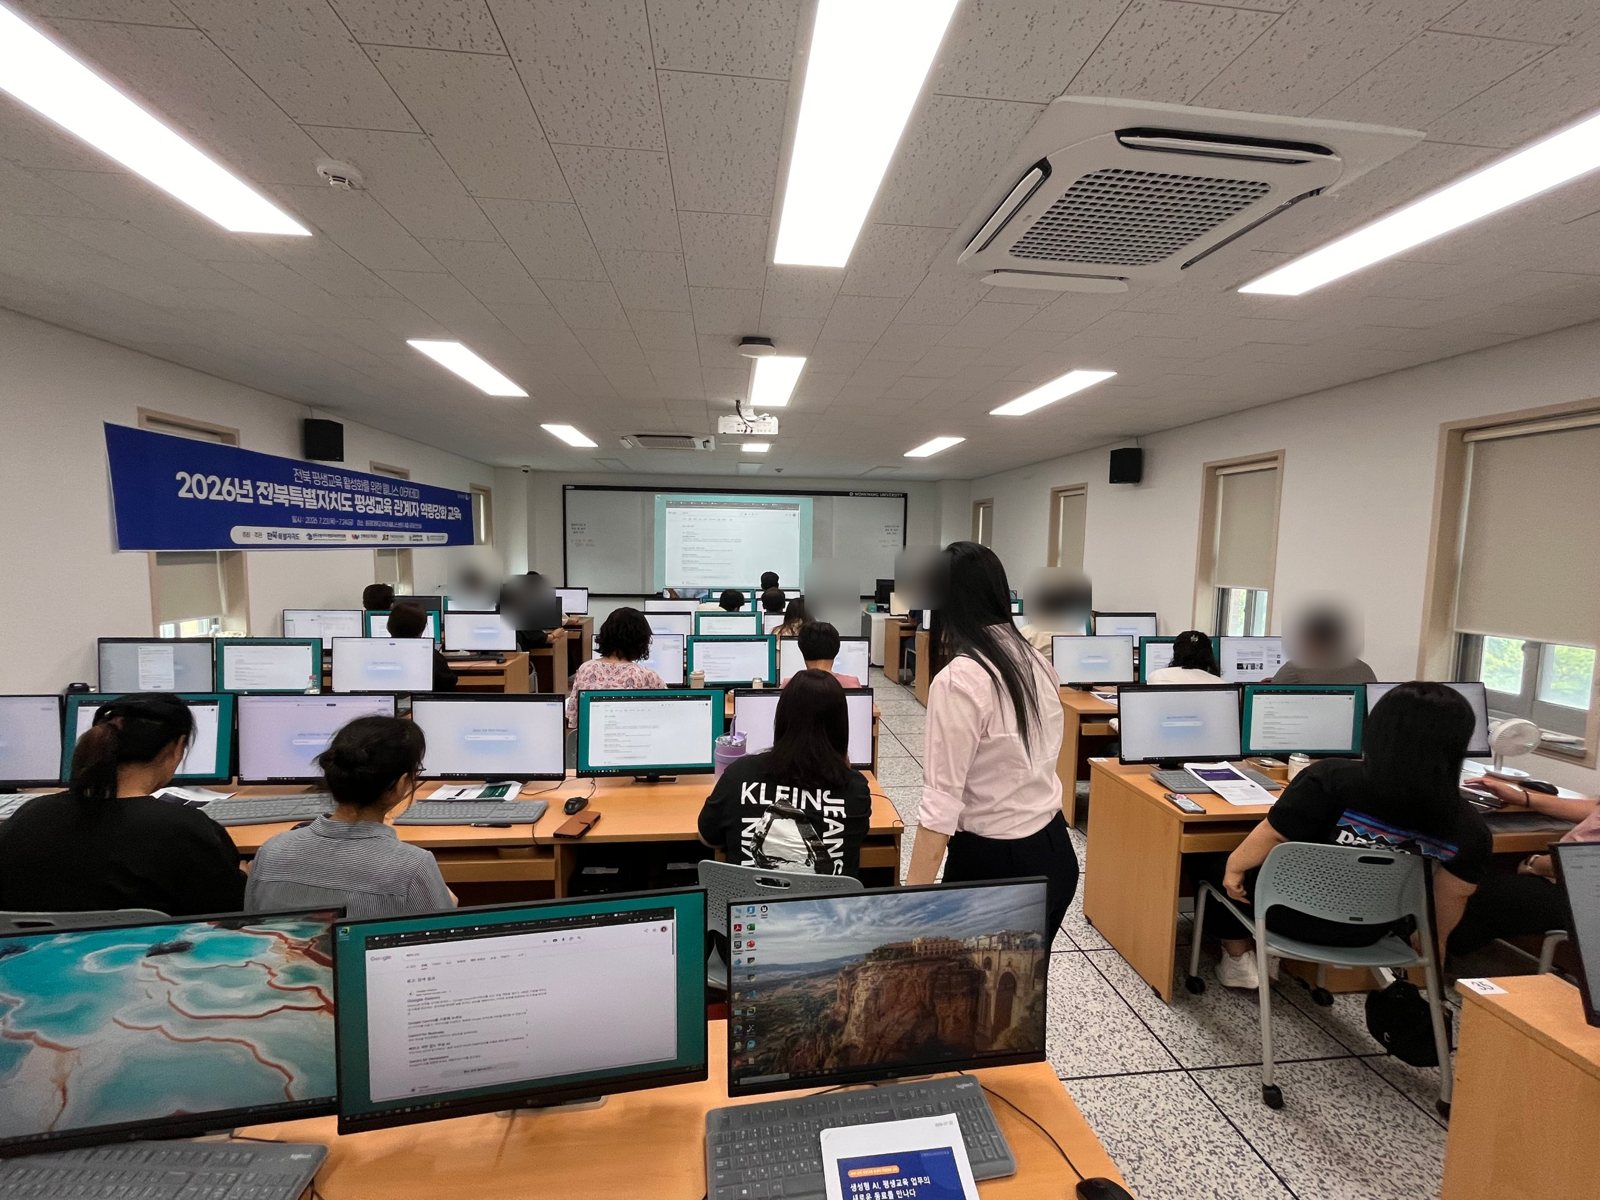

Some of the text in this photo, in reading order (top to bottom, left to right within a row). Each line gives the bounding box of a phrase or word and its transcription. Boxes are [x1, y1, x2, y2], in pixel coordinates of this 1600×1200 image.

[292, 468, 311, 484] 전북
[312, 469, 343, 488] 평생교육
[175, 471, 462, 521] 2026년 전북특별자치도 평생교육 관계자 역량강화 교육
[741, 782, 822, 811] KLEIN
[850, 1181, 870, 1193] 생성형
[882, 1178, 909, 1190] 평생교육
[910, 1176, 931, 1187] 업무의
[874, 1190, 894, 1200] 동료를
[895, 1188, 917, 1200] 만나다
